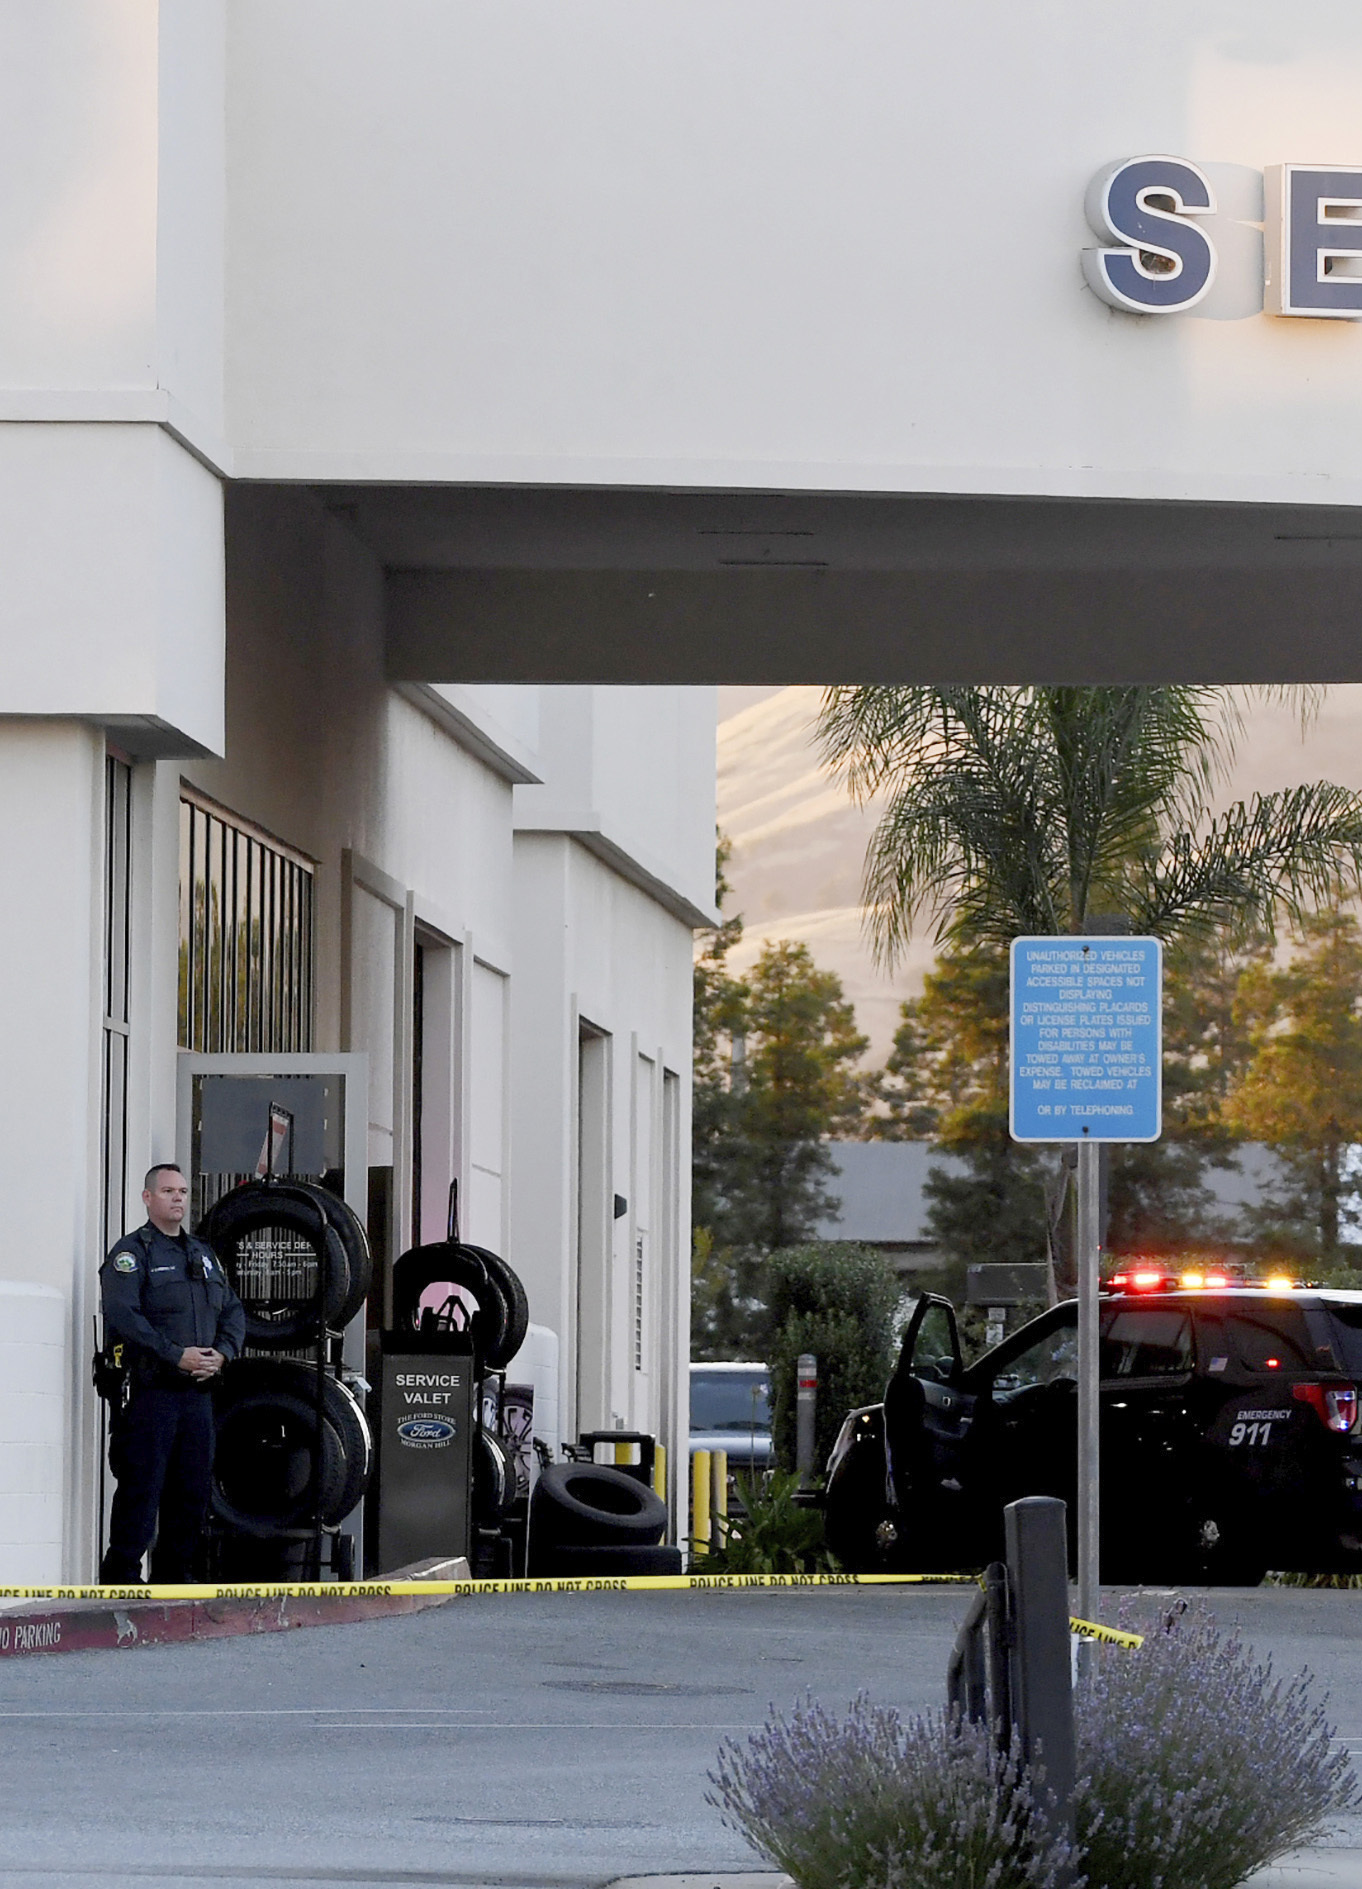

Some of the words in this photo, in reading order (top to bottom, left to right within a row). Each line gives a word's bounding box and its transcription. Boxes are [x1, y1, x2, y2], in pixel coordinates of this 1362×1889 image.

[1026, 950, 1097, 960] UNAUTHORIZED
[1101, 950, 1145, 960] VEHICLES
[1031, 964, 1067, 974] PARKED
[1071, 964, 1080, 974] IN
[1083, 964, 1140, 974] DESIGNATED
[1026, 976, 1083, 986] ACCESSIBLE
[1087, 976, 1123, 986] SPACES
[1126, 976, 1145, 986] NOT
[1059, 990, 1112, 1000] DISPLAYING
[1023, 1002, 1096, 1012] DISTINGUISHING
[1100, 1002, 1148, 1012] PLACARDS
[1020, 1015, 1034, 1025] OR
[1037, 1015, 1076, 1025] LICENSE
[1080, 1015, 1114, 1025] PLATES
[1117, 1015, 1150, 1025] ISSUED
[1040, 1028, 1058, 1038] FOR
[1062, 1028, 1105, 1038] PERSONS
[1109, 1028, 1132, 1038] WITH
[1038, 1041, 1095, 1051] DISABILITIES
[1099, 1041, 1117, 1051] MAY
[1121, 1041, 1133, 1051] BE
[1026, 1054, 1058, 1064] TOWED
[1062, 1054, 1085, 1064] AWAY
[1088, 1054, 1100, 1064] AT
[1071, 1067, 1104, 1076] TOWED
[1108, 1066, 1152, 1076] VEHICLES
[1033, 1080, 1051, 1090] MAY
[1054, 1080, 1067, 1090] BE
[1071, 1080, 1124, 1090] RECLAIMED
[1127, 1080, 1138, 1090] AT
[1038, 1105, 1052, 1115] OR
[1054, 1105, 1067, 1115] BY
[1071, 1105, 1134, 1115] TELEPHONING
[254, 1242, 292, 1250] SERVICE
[248, 1260, 269, 1269] Friday
[396, 1374, 460, 1387] SERVICE
[403, 1392, 451, 1404] VALET
[397, 1414, 412, 1423] THE
[413, 1412, 433, 1420] FORD
[434, 1413, 456, 1424] STORE
[1237, 1409, 1292, 1420] EMERGENCY
[410, 1424, 442, 1438] Ford
[1229, 1422, 1272, 1445] 911
[400, 1439, 433, 1449] MORGAN
[434, 1440, 450, 1448] HILL
[14, 1622, 61, 1649] PARKING
